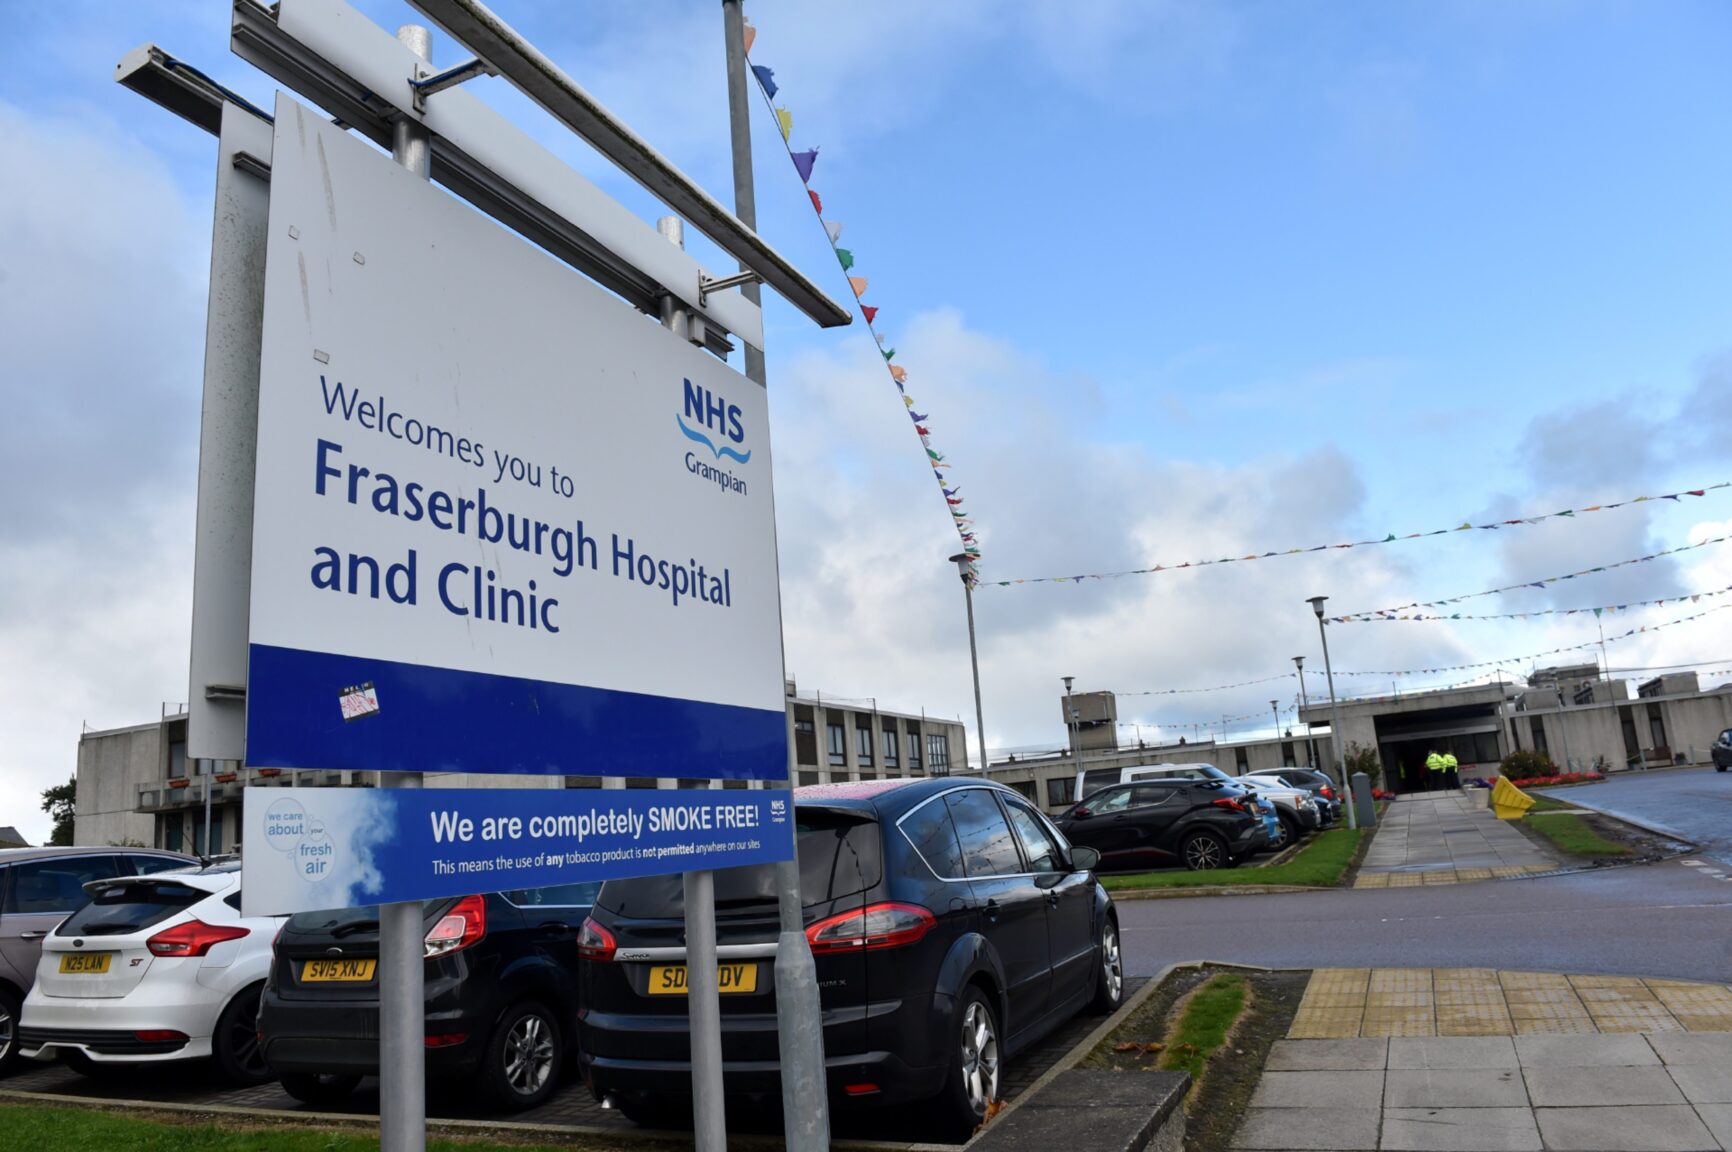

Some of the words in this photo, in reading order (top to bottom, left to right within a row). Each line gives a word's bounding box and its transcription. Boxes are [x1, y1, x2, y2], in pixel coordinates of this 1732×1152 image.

[682, 377, 745, 444] NHS
[319, 374, 485, 468] Welcomes
[494, 449, 541, 488] you
[551, 466, 575, 498] to
[684, 451, 748, 497] Grampian
[314, 437, 599, 578] Fraserburgh
[611, 533, 732, 608] Hospital
[309, 545, 417, 606] and
[437, 561, 560, 635] Clinic
[268, 813, 281, 821] we
[283, 813, 303, 821] care
[430, 811, 474, 844] We
[481, 816, 522, 841] are
[529, 807, 644, 843] completely
[648, 806, 713, 832] SMOKE
[716, 804, 760, 829] FREE!
[771, 800, 785, 811] NHS
[268, 823, 304, 836] about
[300, 842, 332, 857] fresh
[305, 858, 327, 874] air
[432, 859, 456, 875] This
[458, 860, 494, 874] means
[496, 855, 513, 871] the
[515, 856, 533, 869] use
[534, 853, 544, 868] of
[546, 854, 564, 868] any
[566, 851, 600, 864] tobacco
[602, 848, 634, 864] product
[635, 848, 642, 859] is
[643, 845, 657, 858] not
[658, 843, 695, 859] permitted
[696, 842, 727, 854] anywhere
[728, 841, 736, 850] on
[737, 840, 747, 849] our
[748, 837, 761, 848] sites
[310, 962, 338, 977] SV15
[340, 960, 368, 976] XNJ
